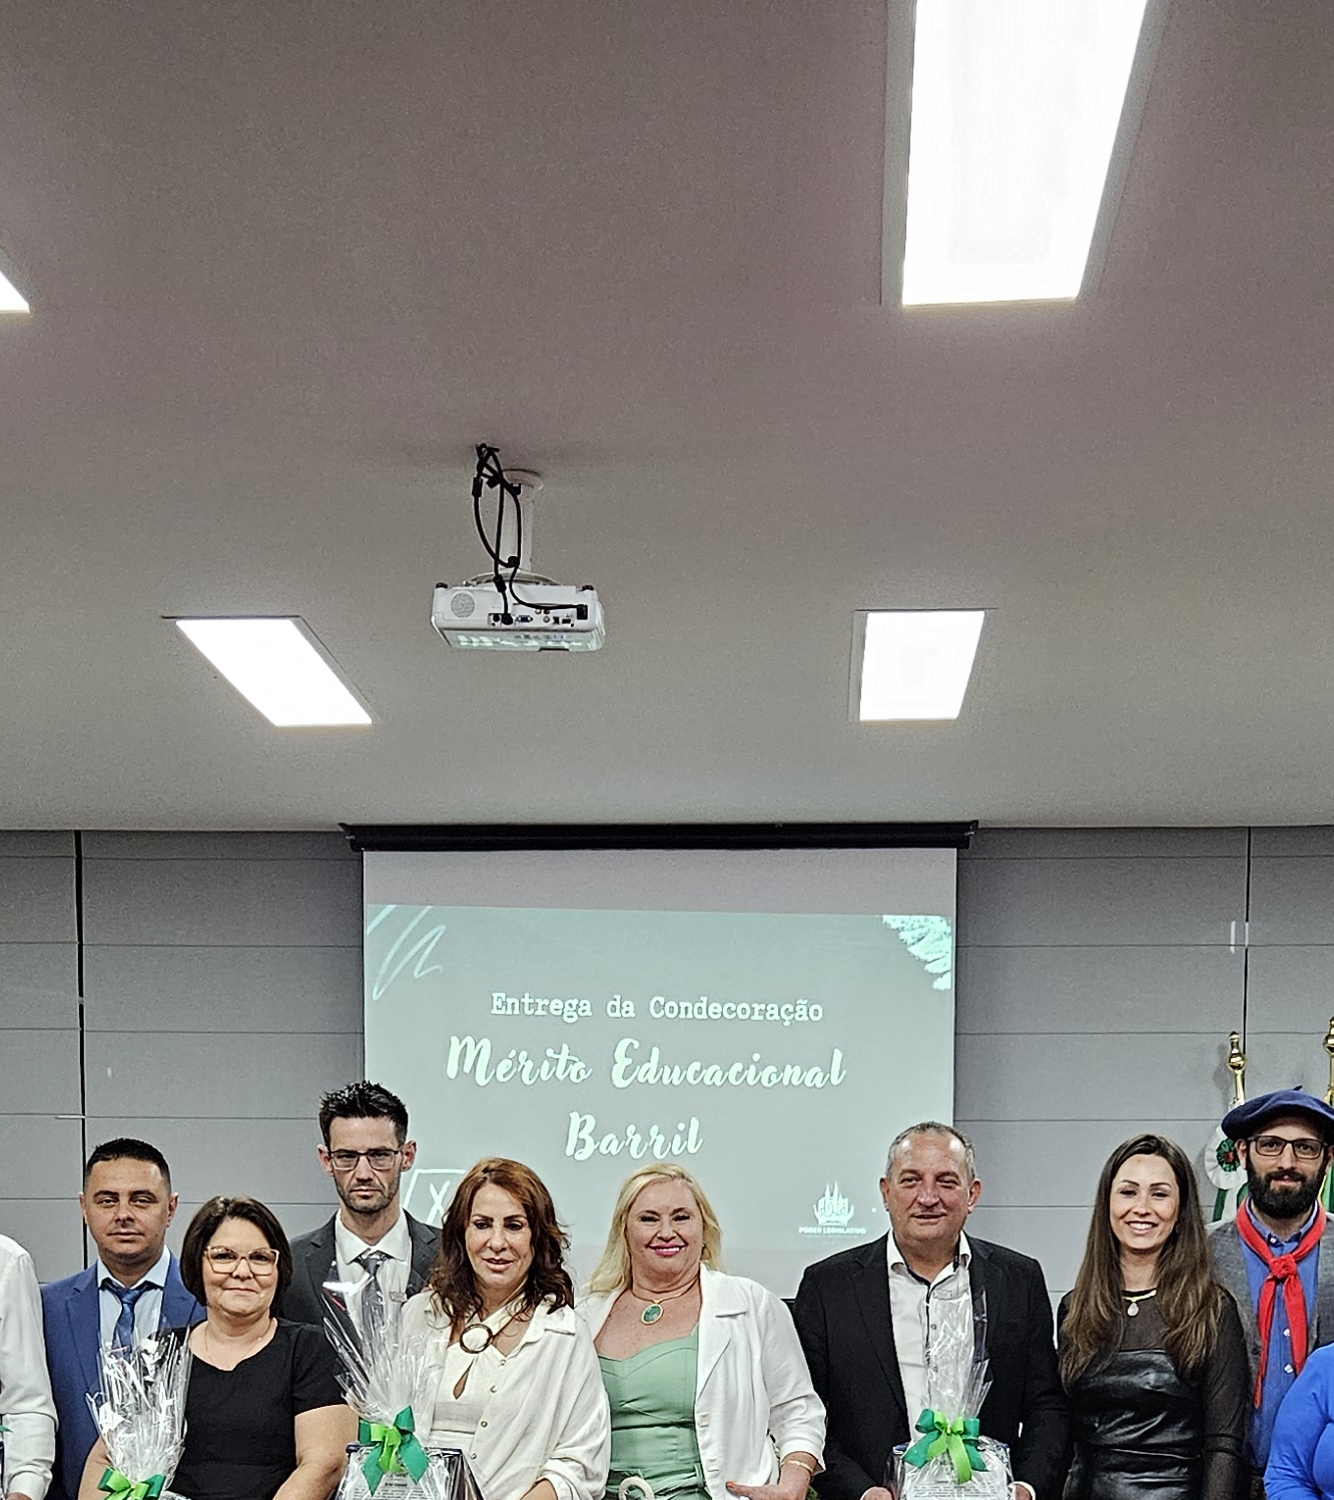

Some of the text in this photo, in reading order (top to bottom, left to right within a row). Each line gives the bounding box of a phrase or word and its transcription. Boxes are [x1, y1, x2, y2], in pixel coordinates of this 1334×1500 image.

[491, 992, 823, 1027] Entrega da Condecoração
[446, 1035, 847, 1089] Mérito Educacional
[565, 1111, 703, 1162] Barril
